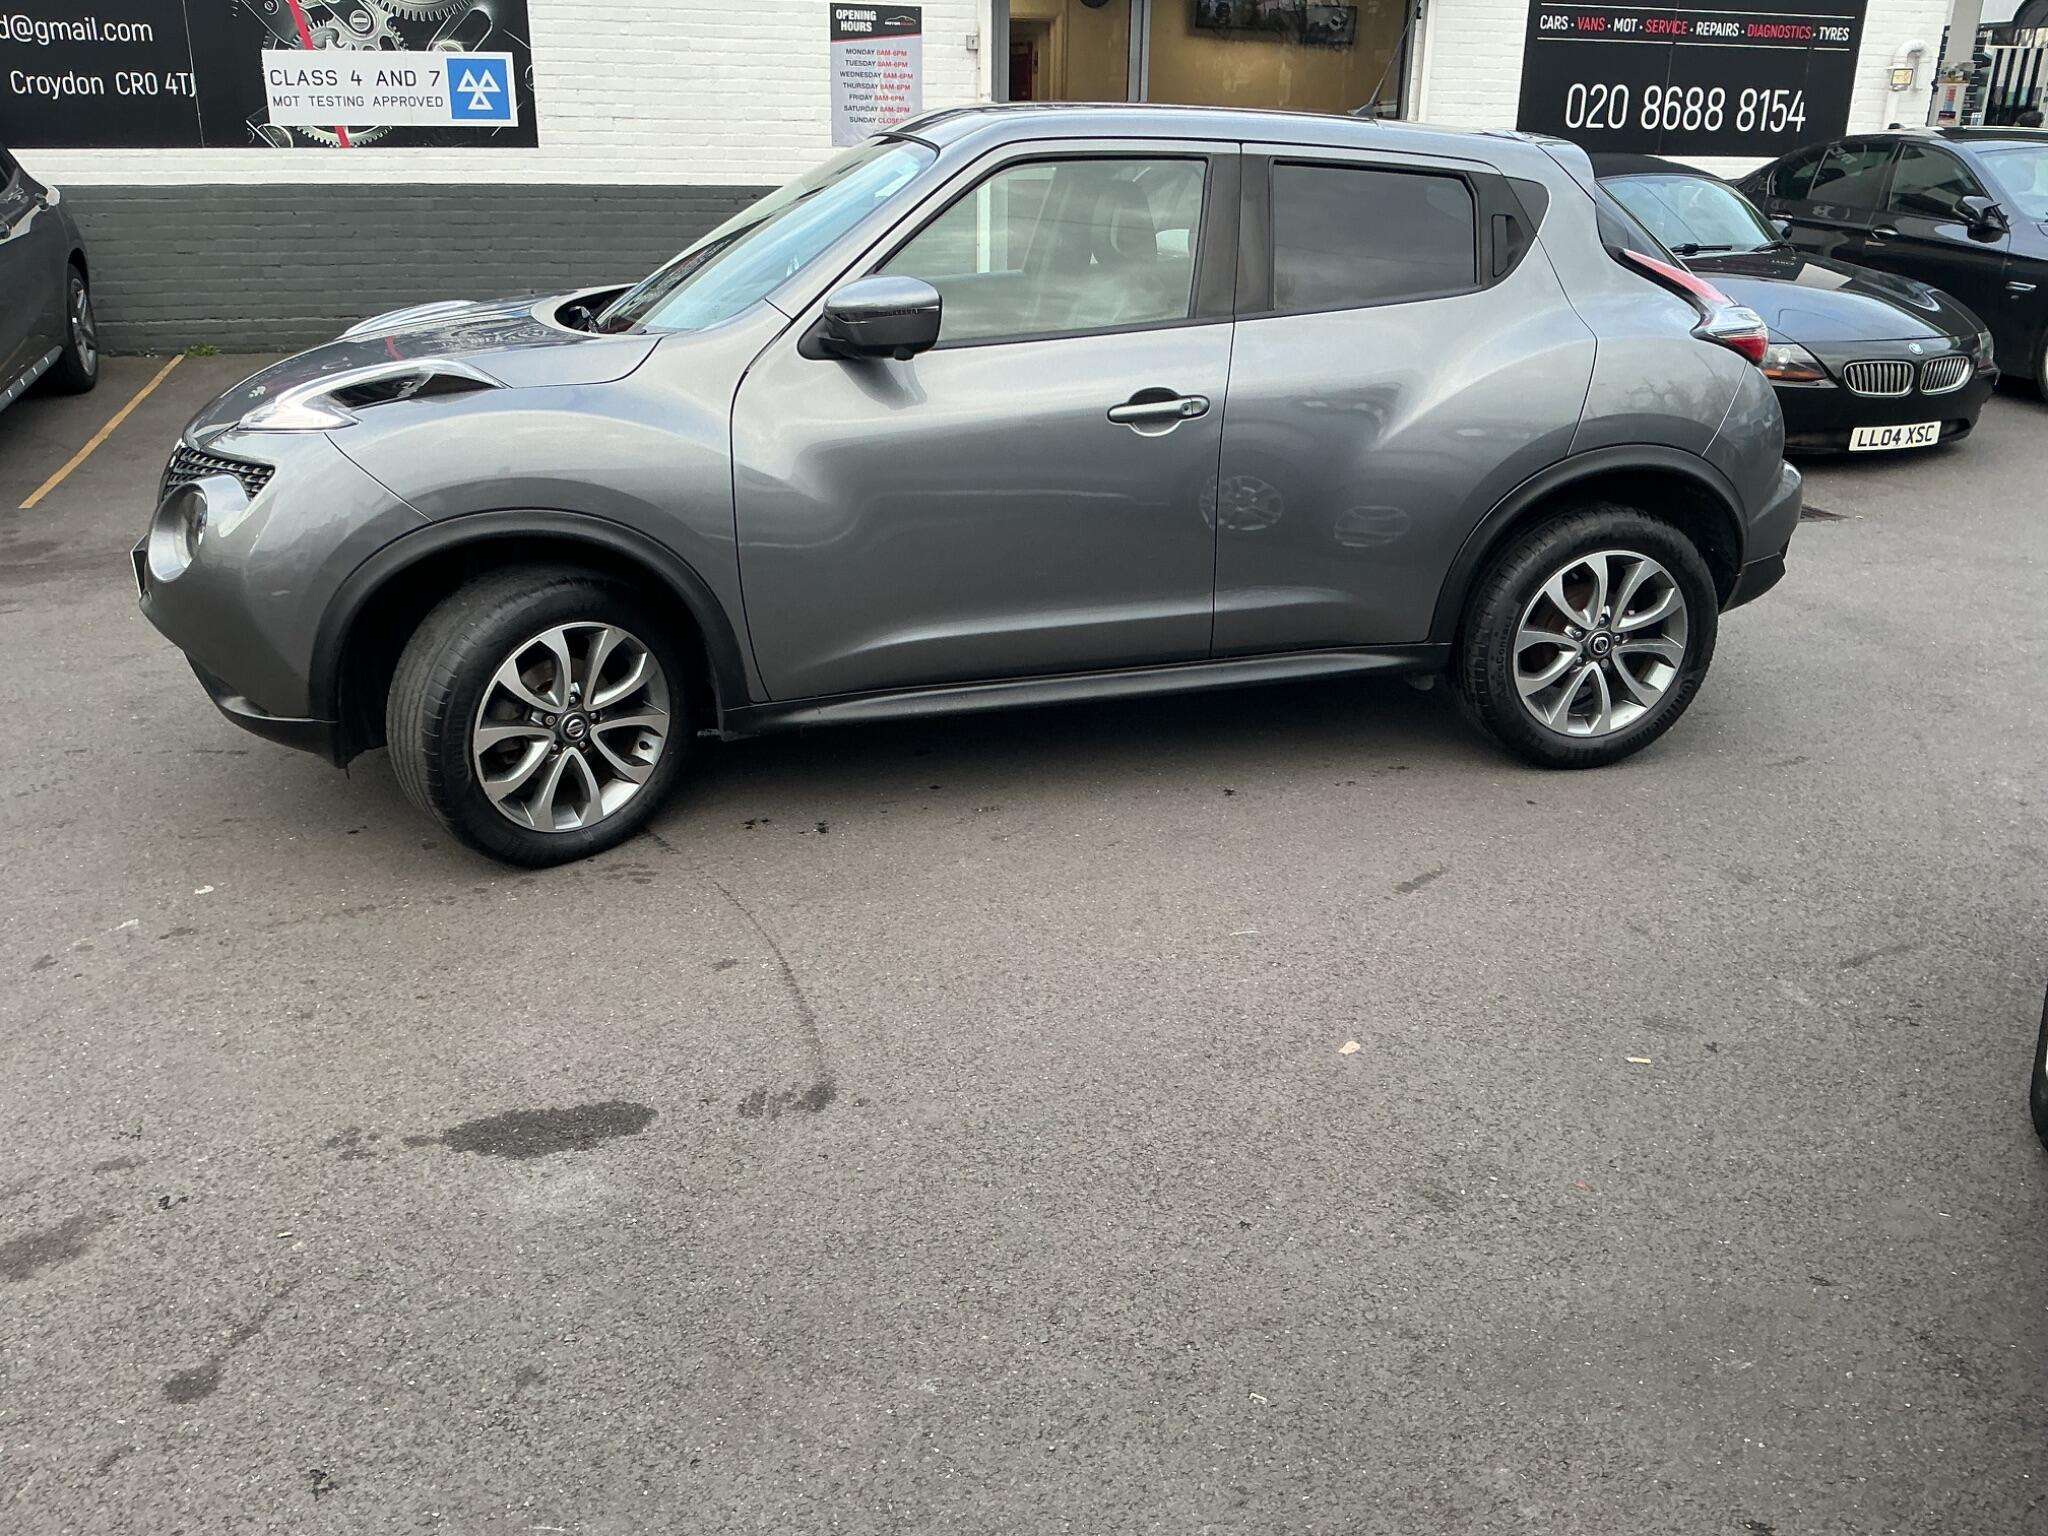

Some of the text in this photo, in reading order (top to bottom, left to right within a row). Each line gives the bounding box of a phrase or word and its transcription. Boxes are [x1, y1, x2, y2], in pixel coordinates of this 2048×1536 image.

[836, 9, 877, 20] OPENING
[841, 21, 872, 32] HOURS
[1540, 15, 1850, 42] CARS VANS MOT SERVICE REPAIRS DIAGNOSTICS TYRES
[269, 69, 441, 87] CLASS 4 AND 7
[840, 71, 881, 79] WEDNESDAY
[10, 70, 104, 100] Croydon
[165, 72, 196, 97] 4TJ
[843, 82, 878, 90] THURSDAY
[272, 95, 444, 108] MOT TESTING APPROVED
[1565, 84, 1807, 134] 020 8688 8154
[1905, 424, 1934, 444] XSC
